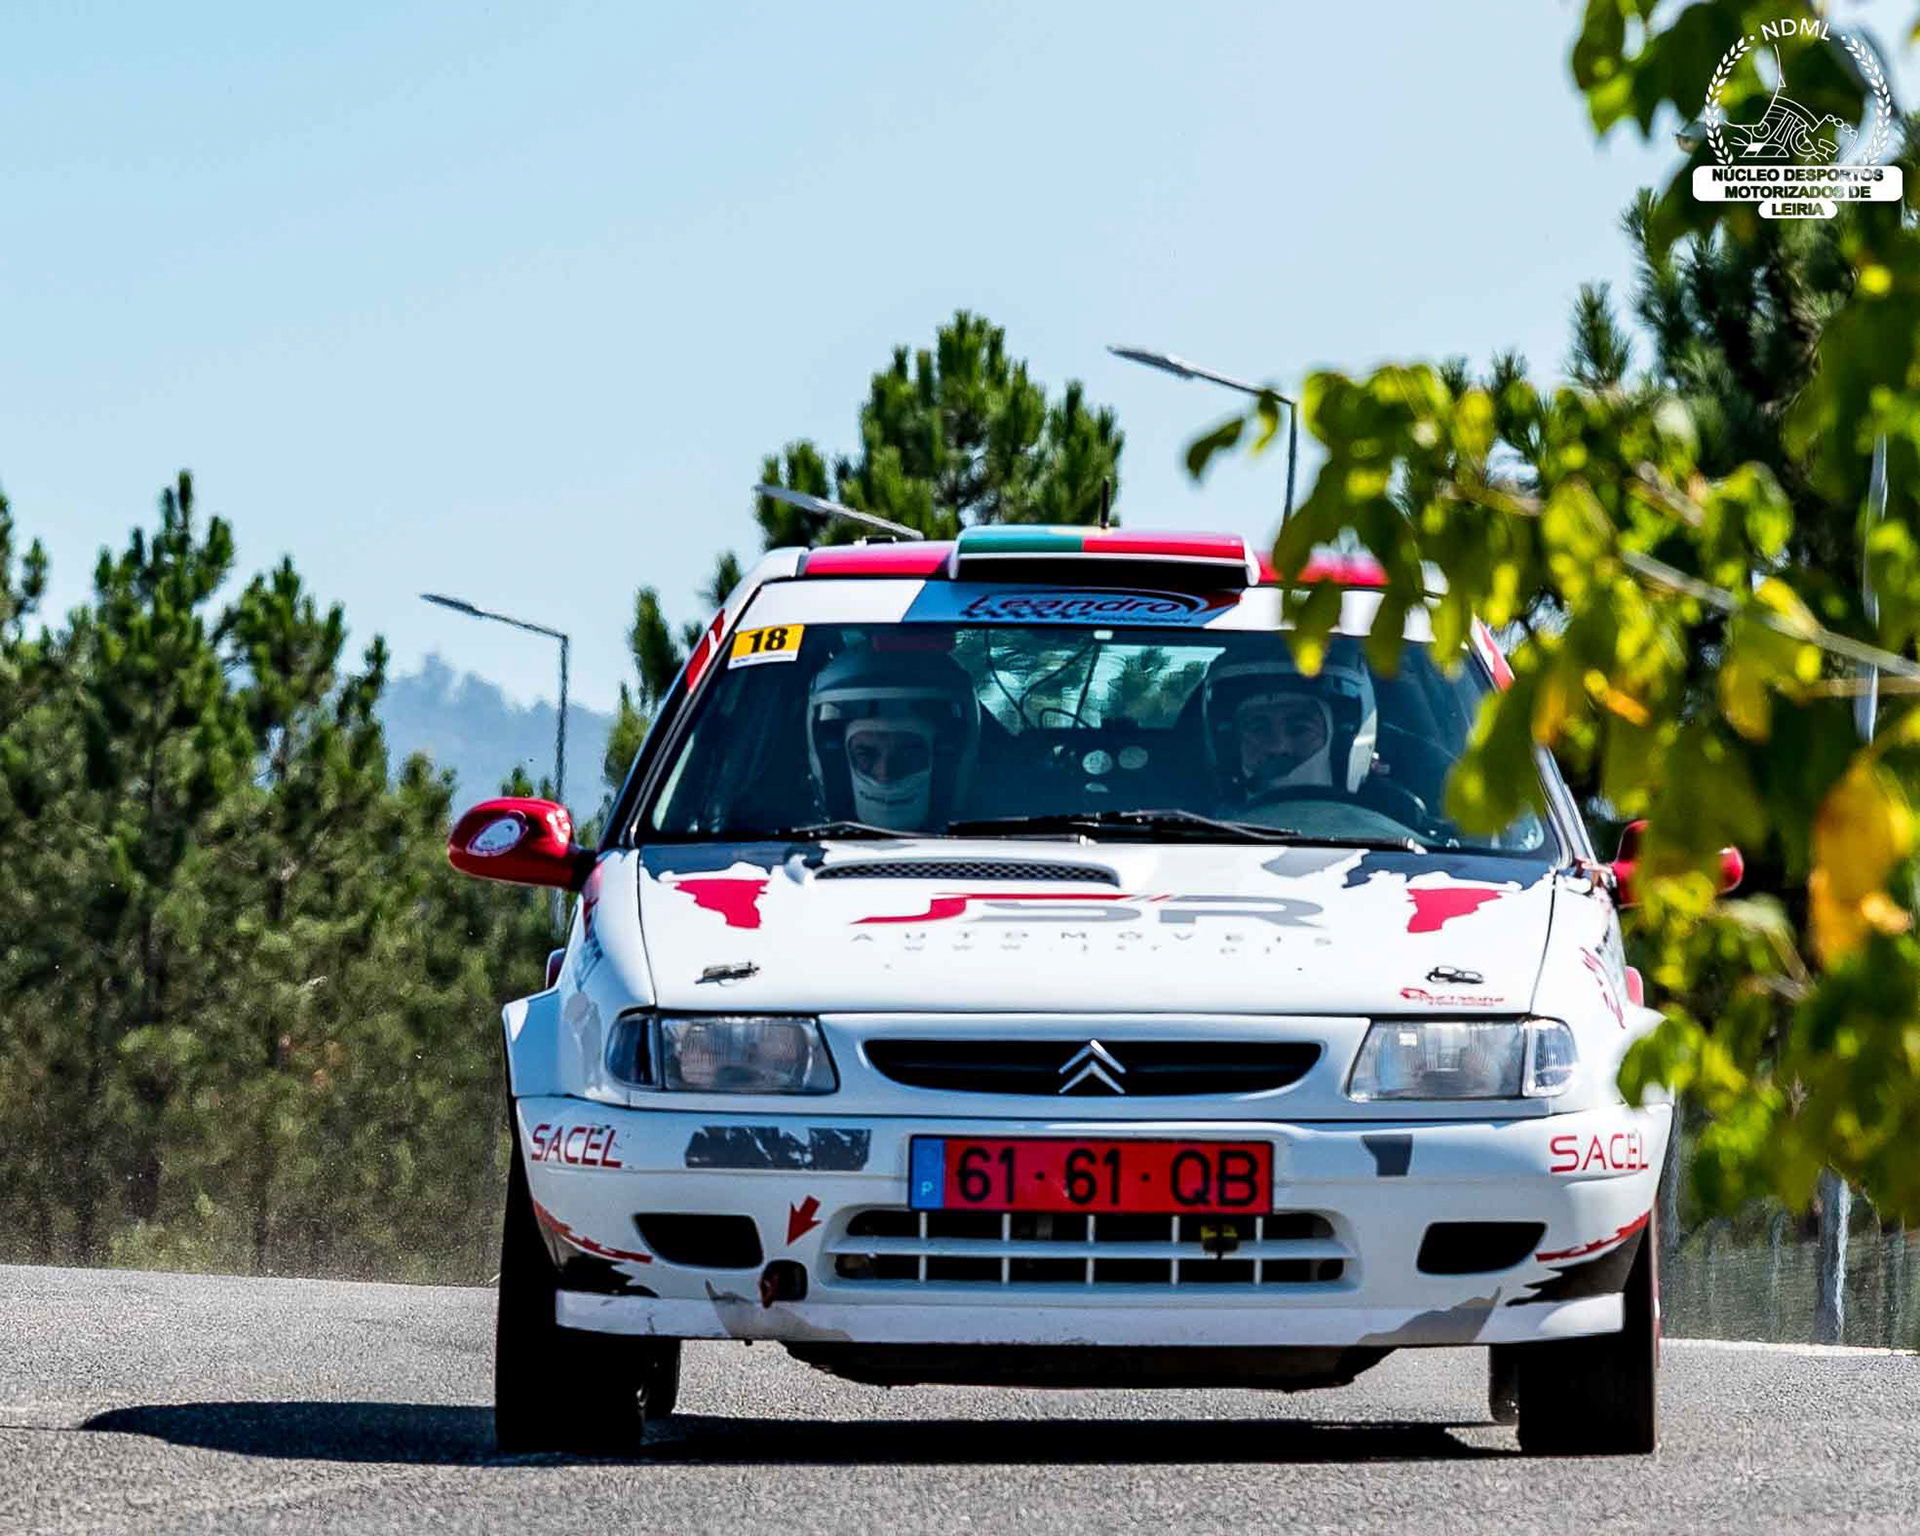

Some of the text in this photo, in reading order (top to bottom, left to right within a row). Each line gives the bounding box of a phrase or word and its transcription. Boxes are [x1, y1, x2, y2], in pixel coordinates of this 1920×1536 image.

[966, 594, 1180, 614] Leandro
[748, 627, 789, 654] 18
[849, 892, 1328, 928] JSR
[531, 1122, 623, 1169] SACEL
[1549, 1134, 1649, 1173] SACEL
